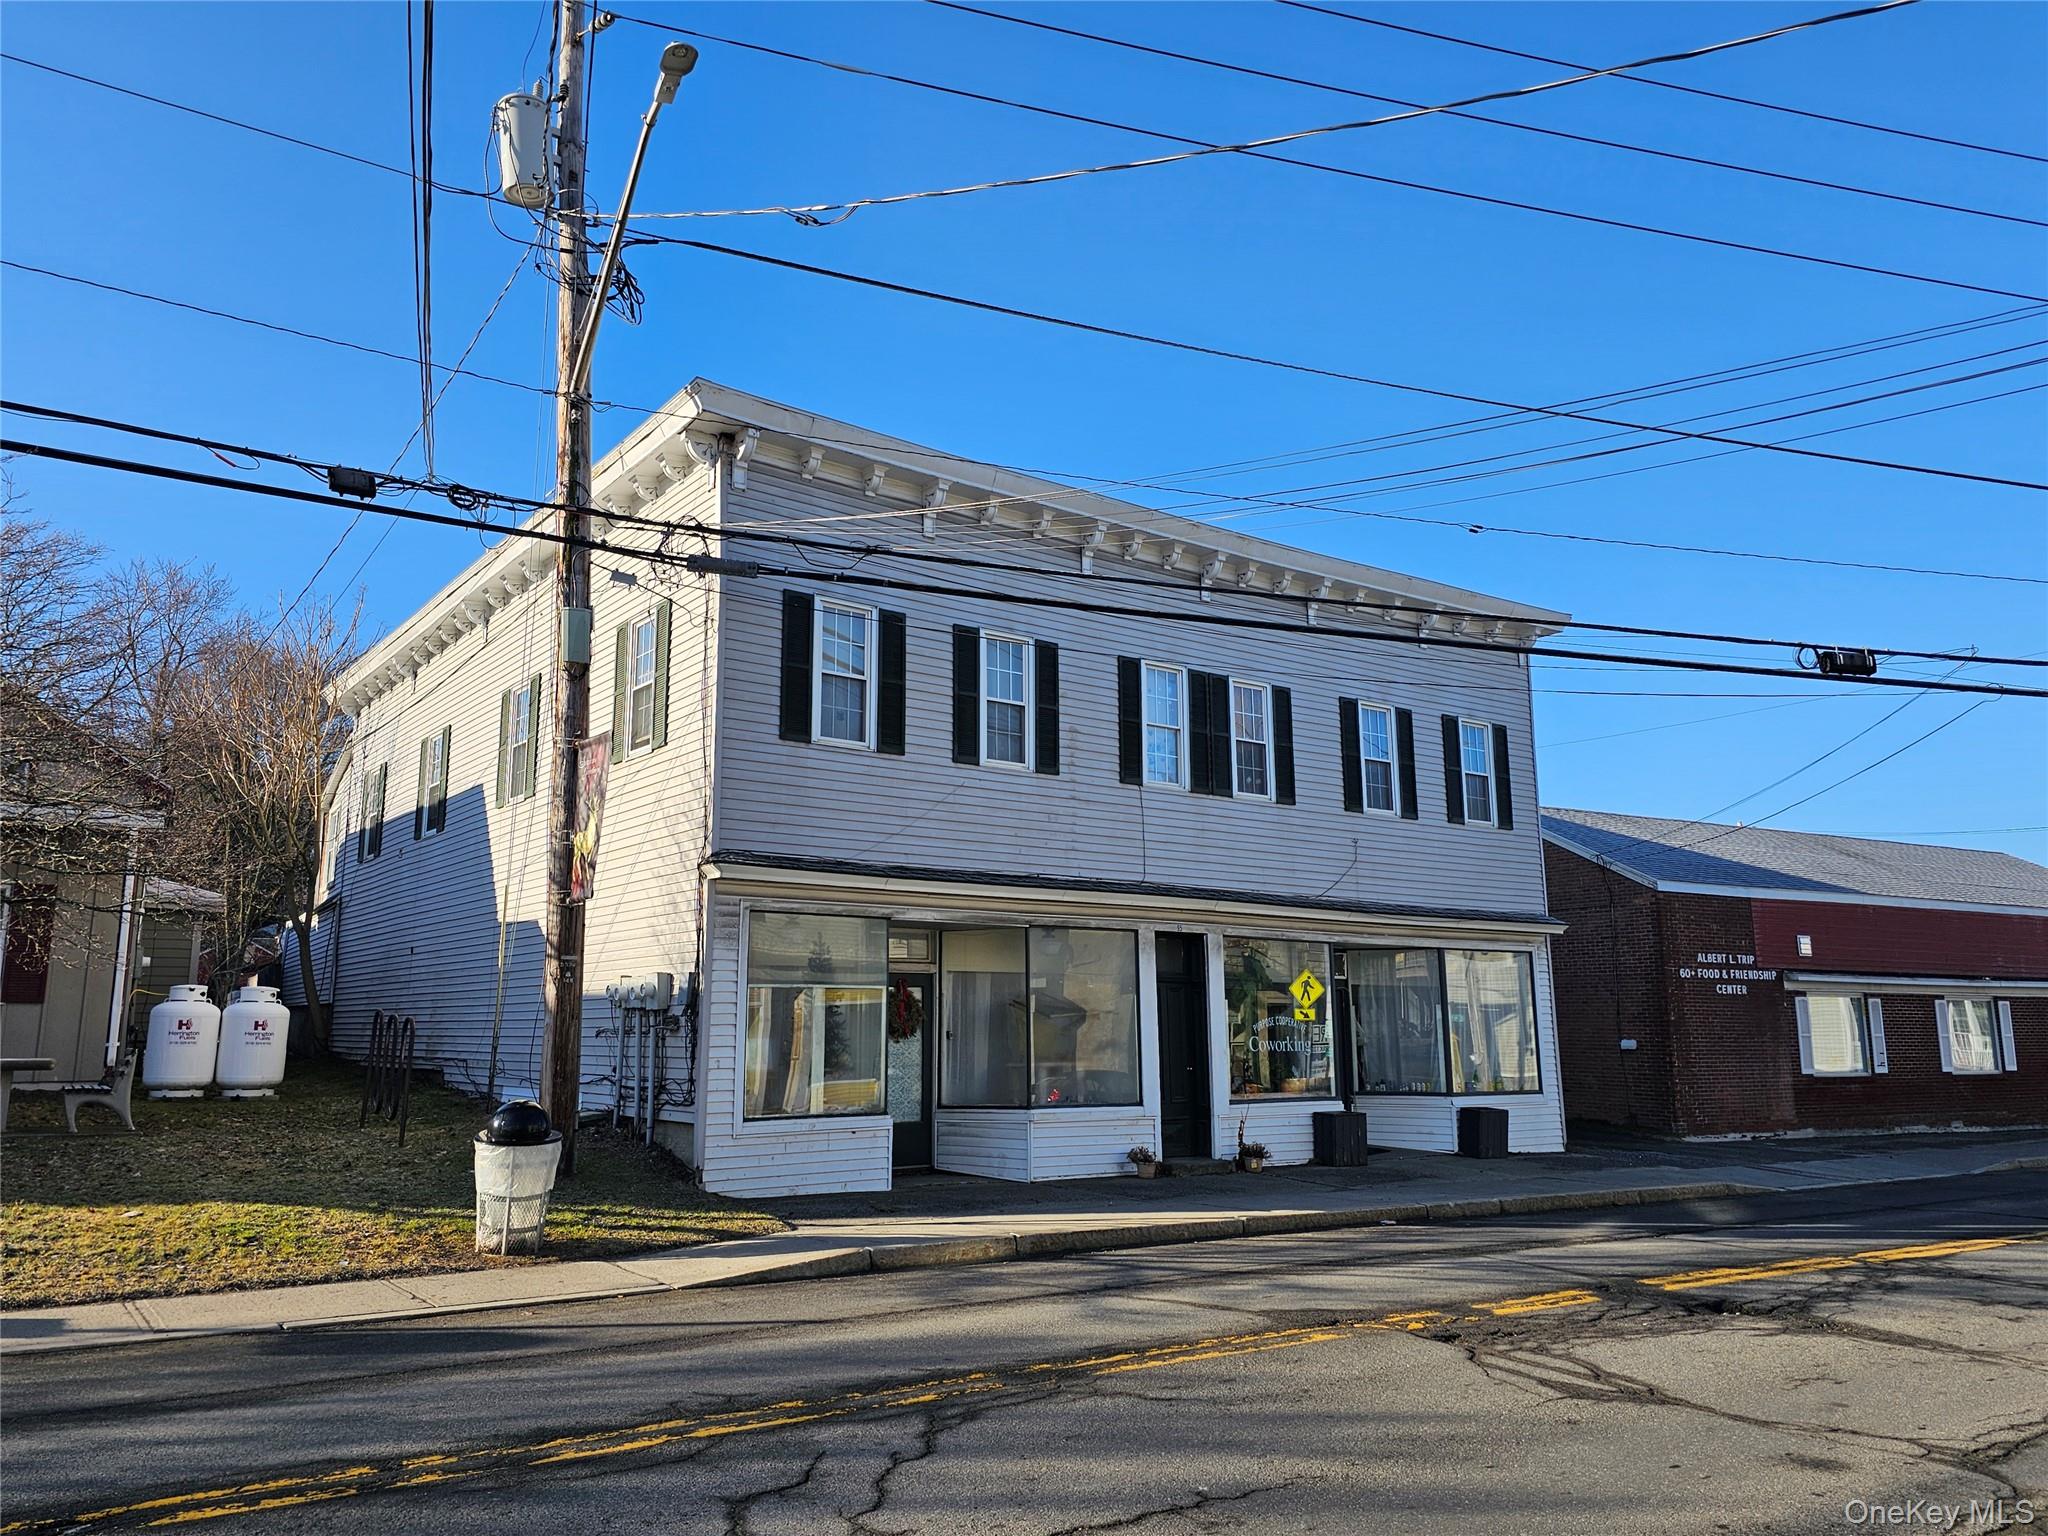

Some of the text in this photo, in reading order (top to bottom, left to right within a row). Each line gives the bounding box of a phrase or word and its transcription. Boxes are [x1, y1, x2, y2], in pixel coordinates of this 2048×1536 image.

[1697, 953, 1726, 964] ALBERT
[1736, 955, 1755, 965] TRIP
[1680, 968, 1777, 981] 60+ FOOD & FRIENDSHIP
[1716, 984, 1748, 995] CENTER
[1252, 1016, 1275, 1033] PURPOSE
[1249, 1035, 1312, 1056] Coworking
